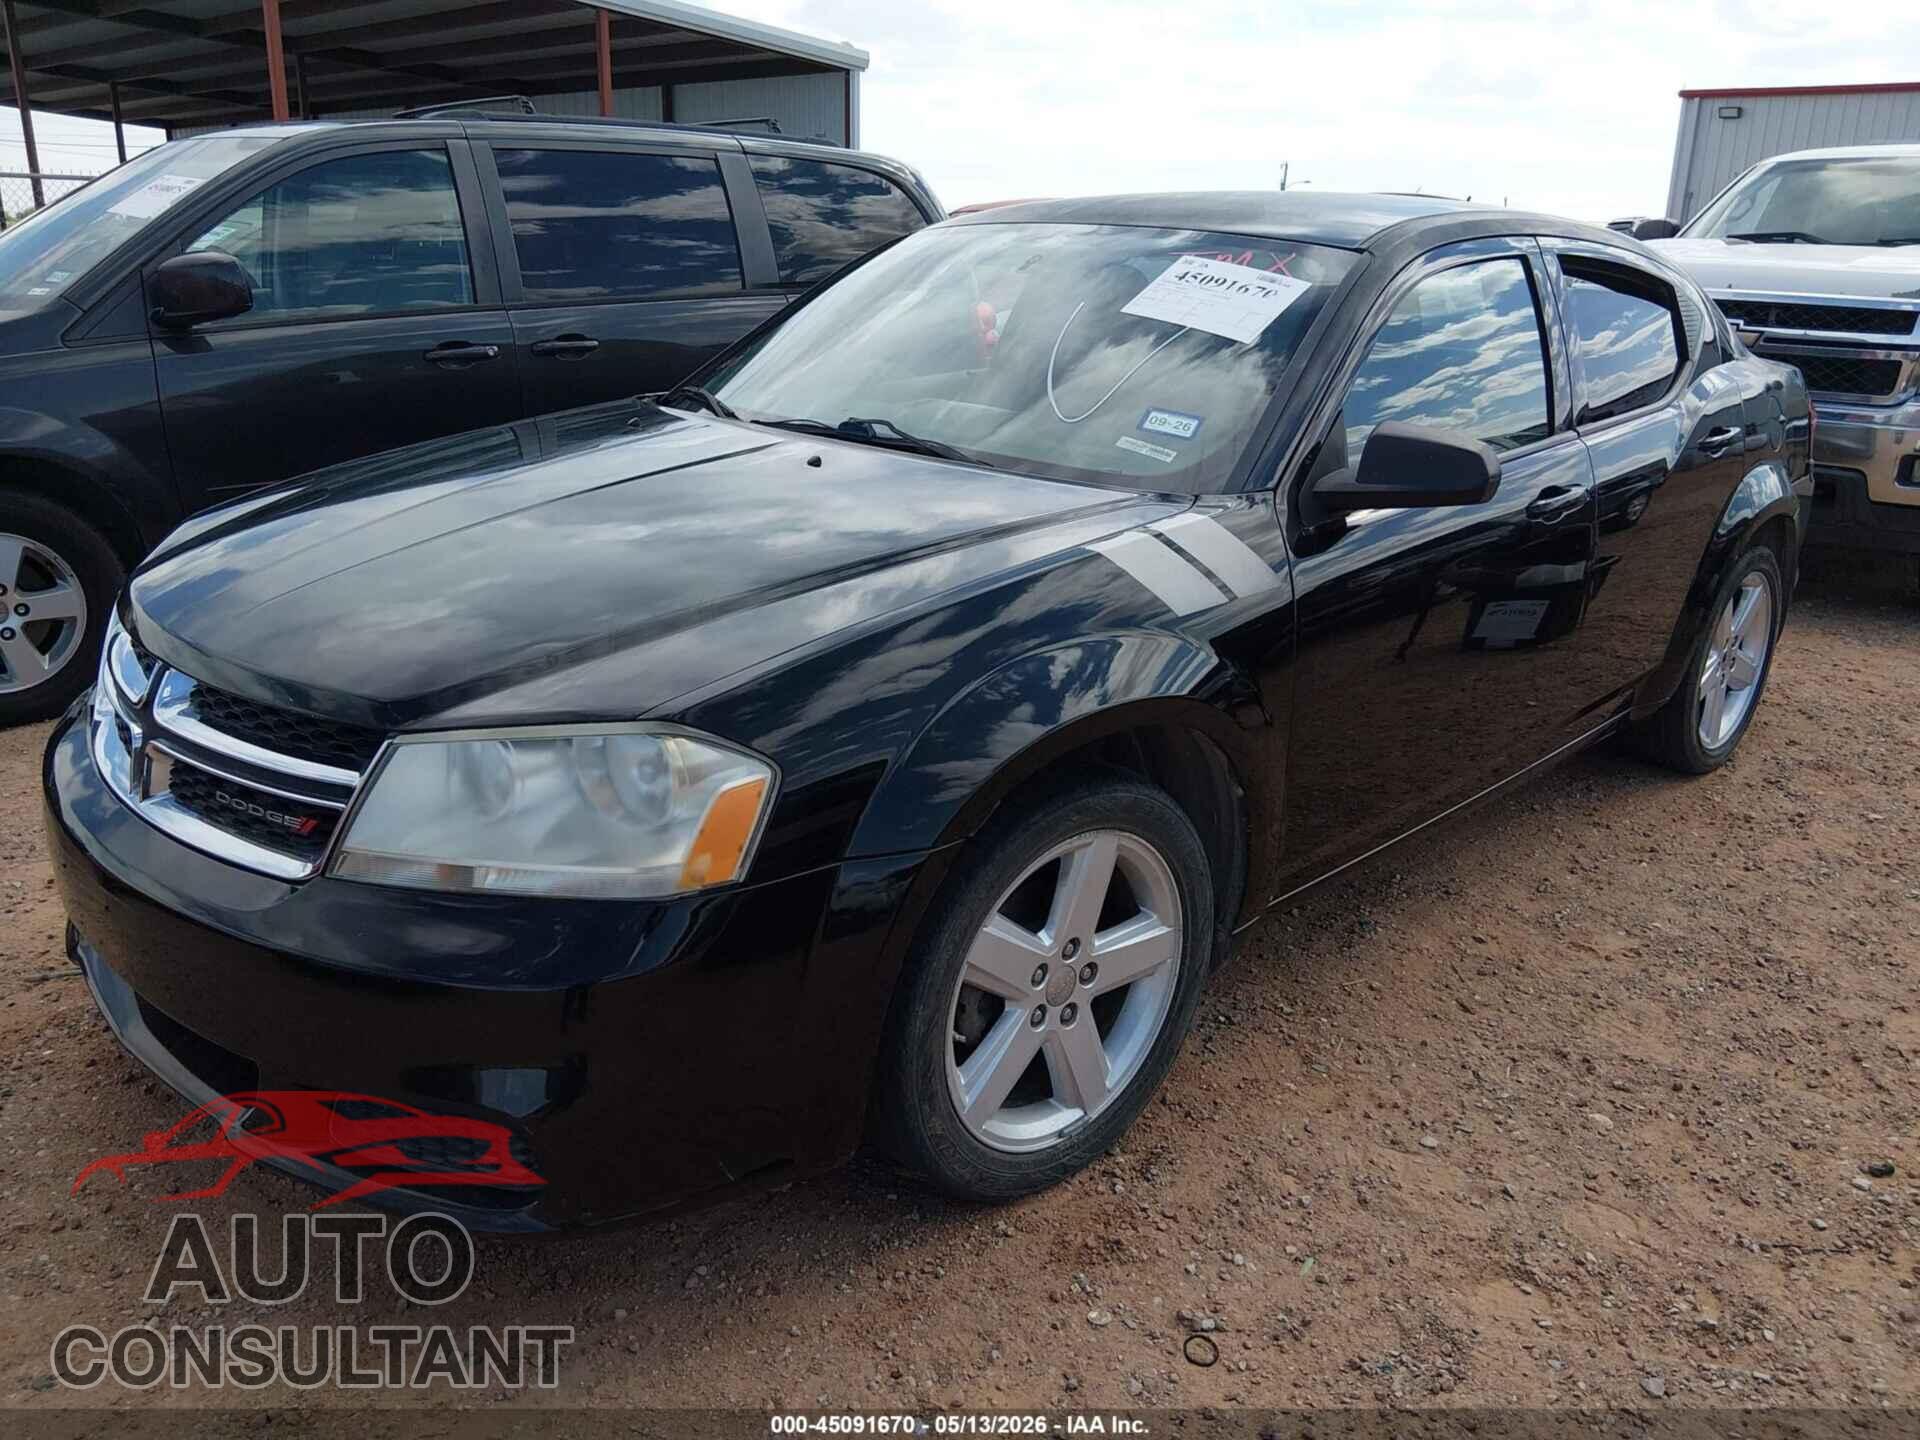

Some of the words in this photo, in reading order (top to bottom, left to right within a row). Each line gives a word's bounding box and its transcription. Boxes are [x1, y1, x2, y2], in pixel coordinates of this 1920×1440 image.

[1174, 270, 1279, 299] 45091670
[1148, 415, 1193, 432] 09-26
[215, 790, 305, 829] DODGE
